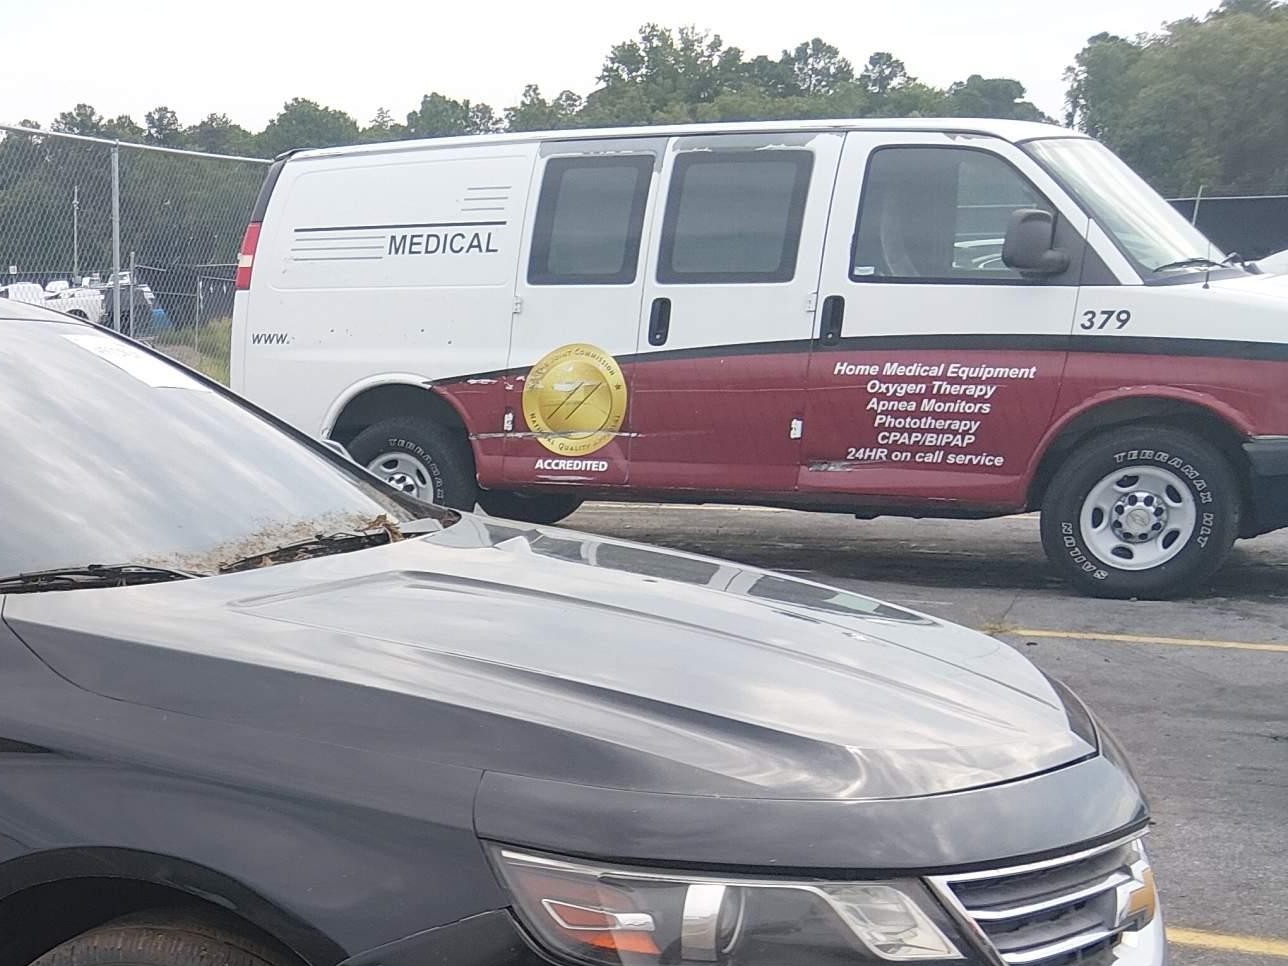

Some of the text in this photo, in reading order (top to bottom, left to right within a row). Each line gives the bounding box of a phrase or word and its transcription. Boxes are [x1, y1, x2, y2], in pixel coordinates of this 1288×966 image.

[388, 232, 498, 255] MEDICAL
[1080, 309, 1131, 330] 379
[833, 362, 1037, 380] Home Medical Equipment
[866, 380, 997, 398] Oxygen Therapy
[866, 398, 991, 413] Apnea Monitors
[874, 415, 981, 433] Phototherapy
[877, 432, 976, 447] CPAP/BIPAP
[535, 459, 608, 472] ACCREDITED
[847, 448, 1004, 466] 24HR on call service
[1113, 450, 1213, 504] TERRAMAX
[1062, 522, 1110, 580] SAILUN
